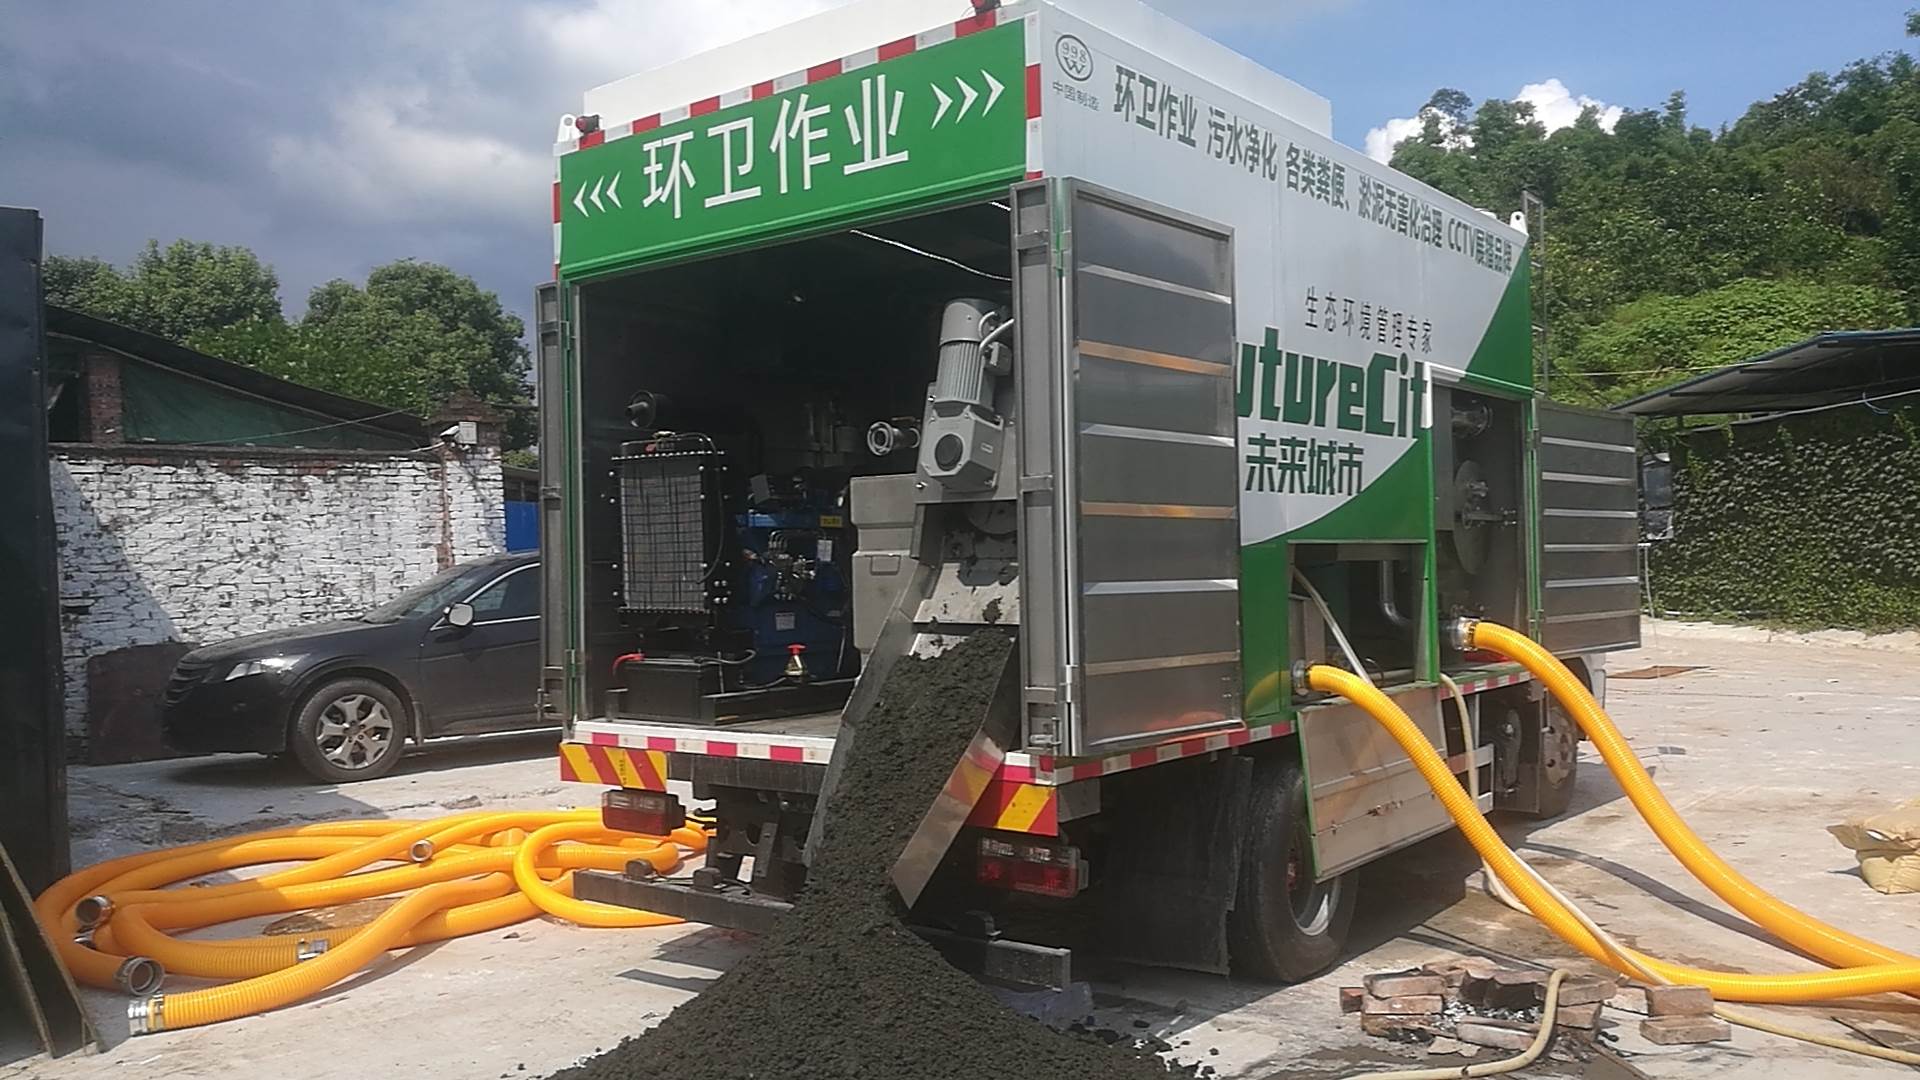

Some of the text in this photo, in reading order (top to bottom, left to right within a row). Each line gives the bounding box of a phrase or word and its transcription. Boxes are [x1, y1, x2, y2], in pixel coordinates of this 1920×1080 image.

[1061, 42, 1087, 64] 998
[1052, 81, 1100, 112] 中国制造
[1113, 65, 1198, 148] 环卫作业
[1207, 106, 1277, 181] 污水净化
[642, 73, 909, 219] 环卫作业
[1305, 285, 1432, 355] 生态环境管理专家
[1245, 432, 1364, 496] 未来城市
